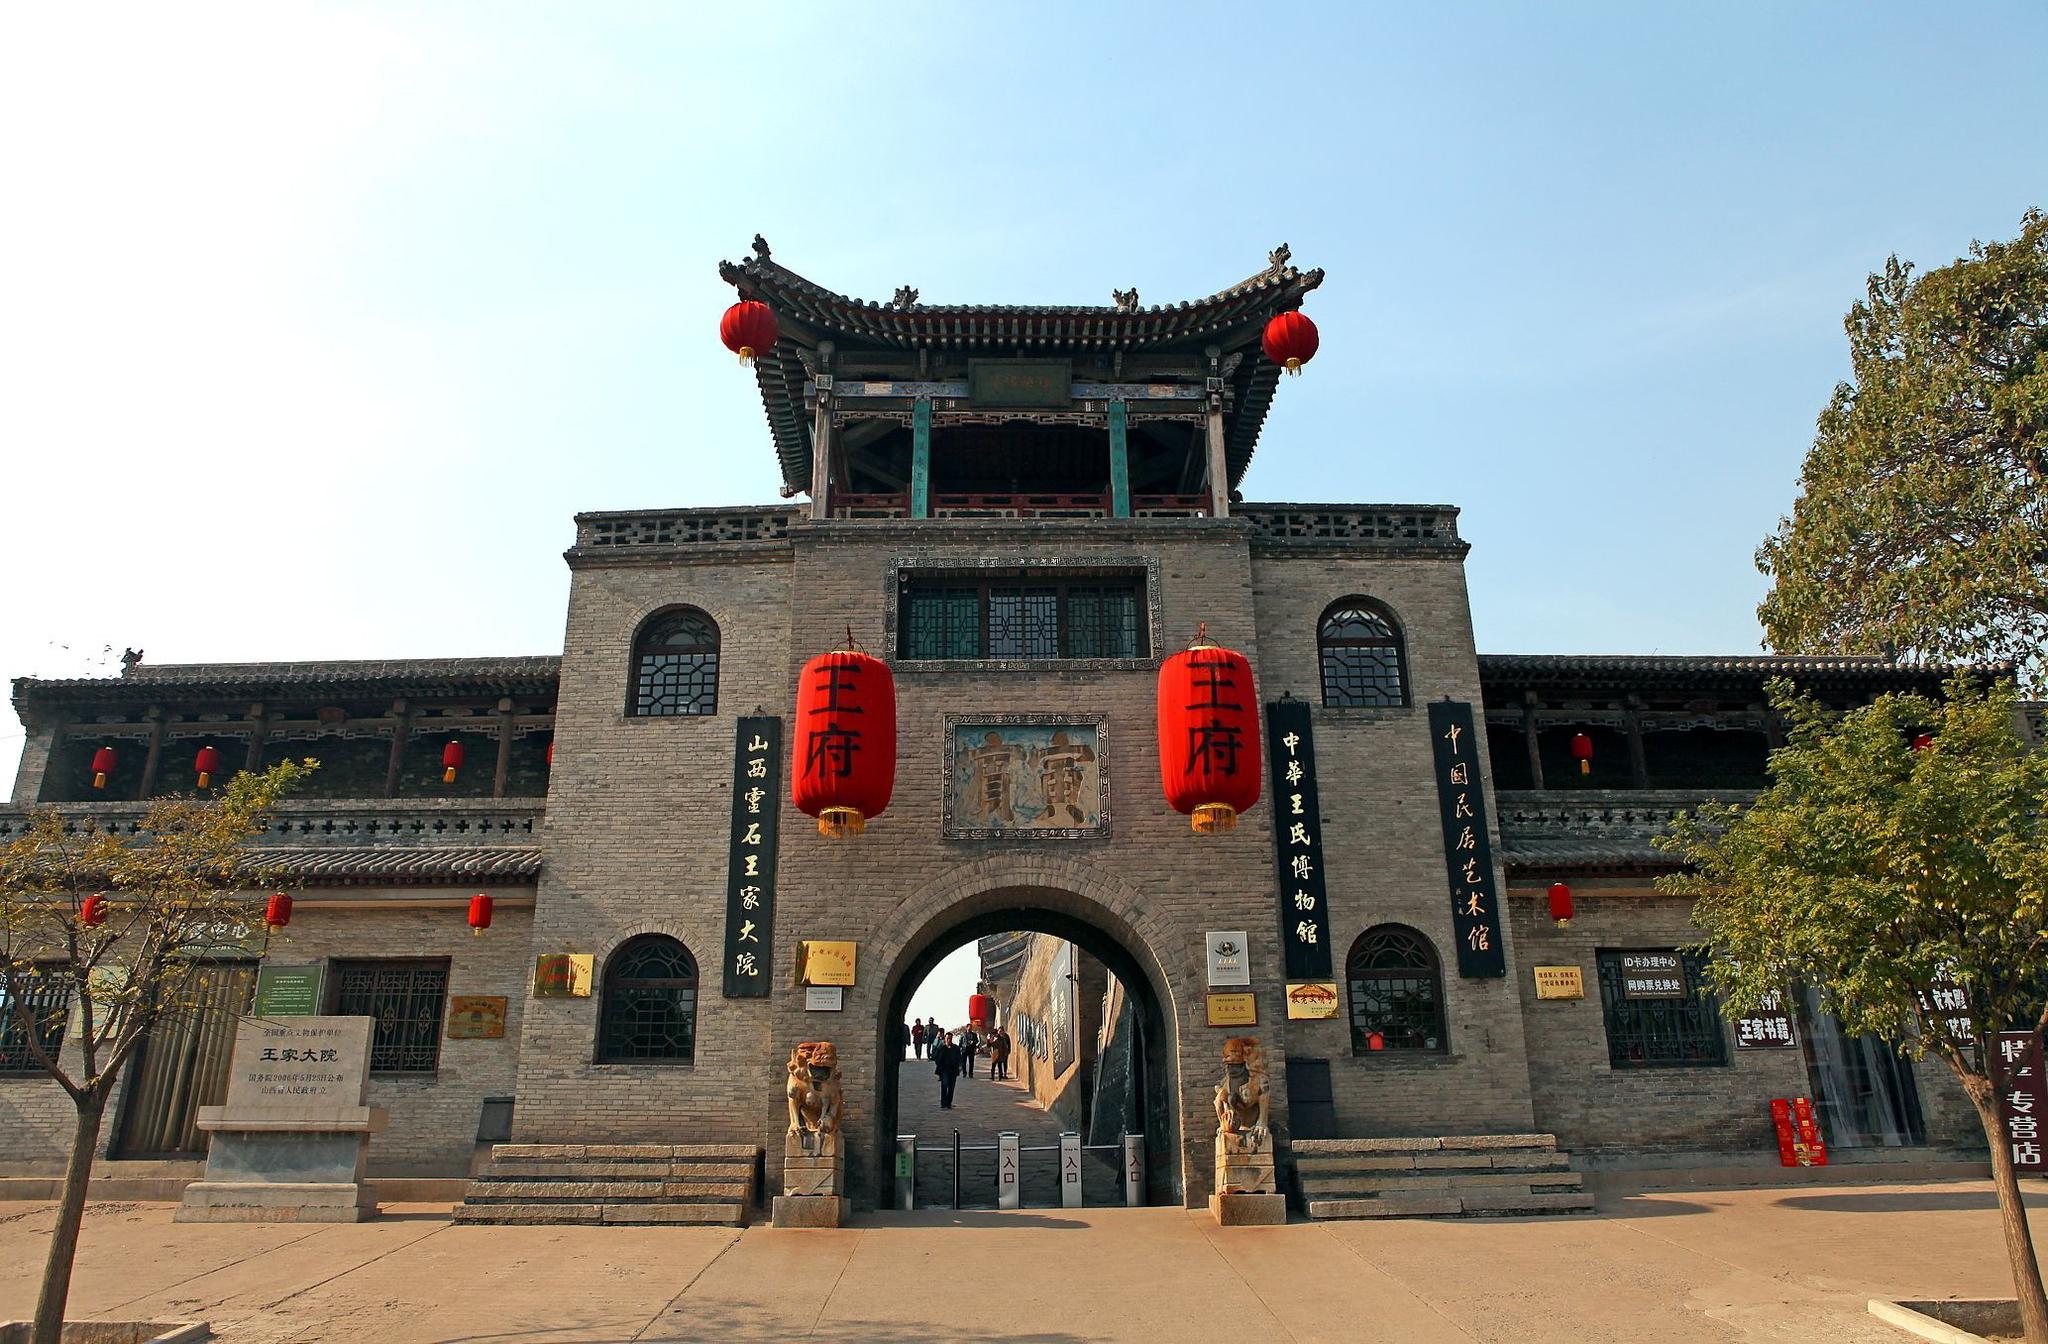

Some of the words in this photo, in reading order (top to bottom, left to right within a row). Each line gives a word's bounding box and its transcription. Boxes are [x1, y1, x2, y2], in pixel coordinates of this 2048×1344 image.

[801, 664, 865, 780] 王府
[1184, 661, 1244, 775] 王府
[1624, 956, 1677, 968] ID卡办理中心
[1627, 979, 1681, 991] 网购票兑换处
[1740, 1017, 1789, 1040] 王家书籍
[259, 1048, 339, 1063] 王家大院
[1003, 1156, 1015, 1184] 入口
[1066, 1156, 1078, 1183] 入口
[1130, 1154, 1142, 1182] 入口
